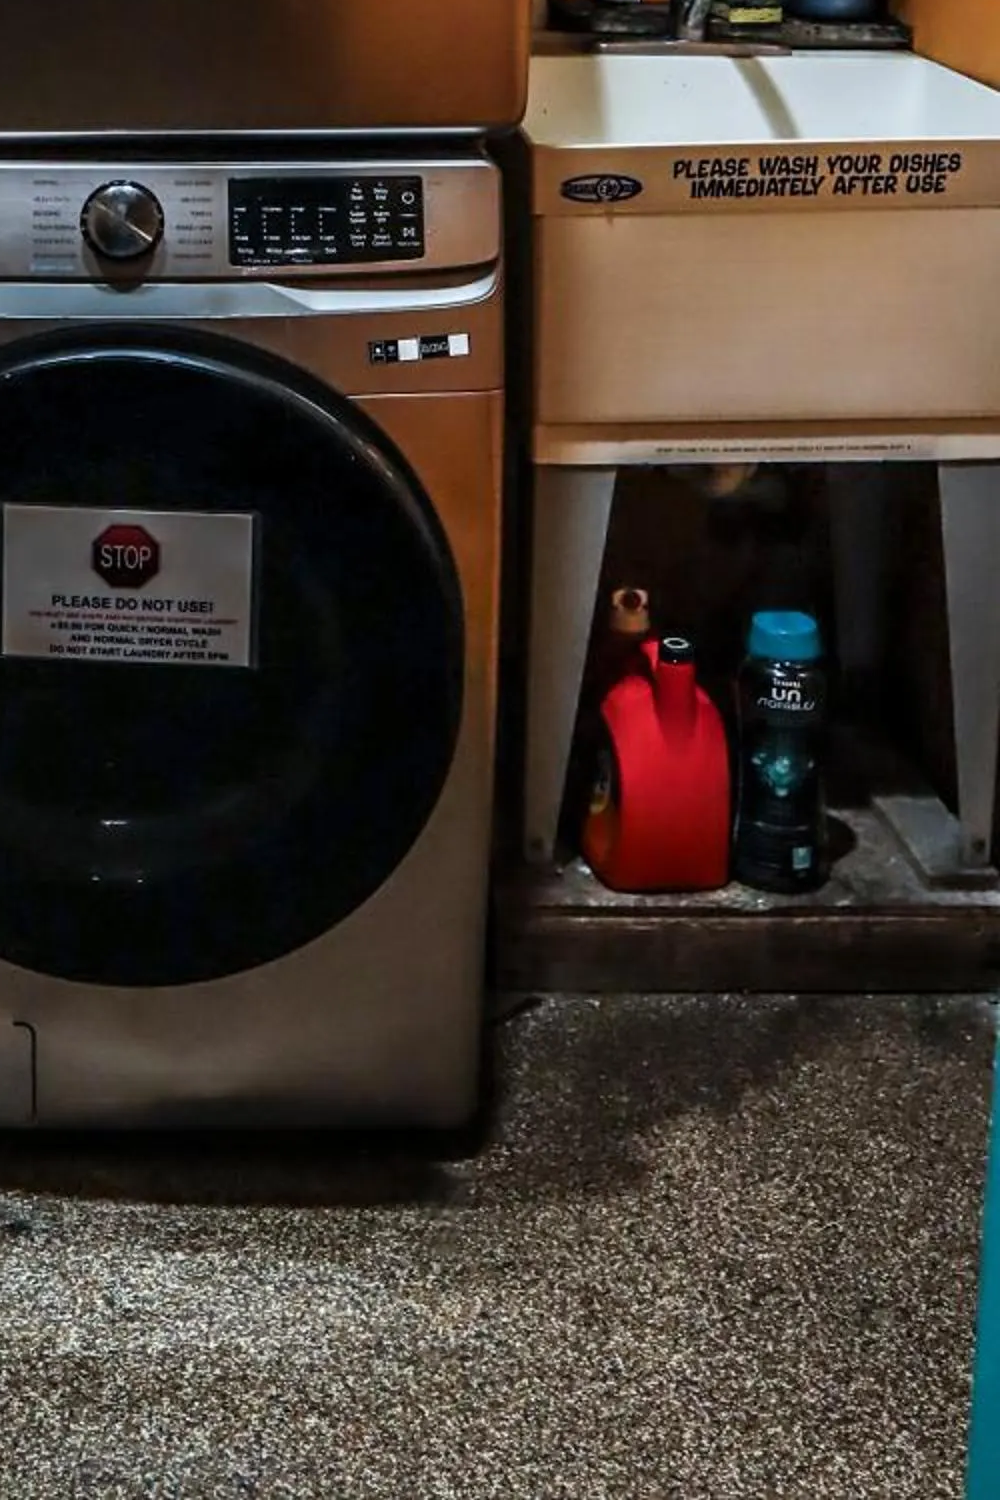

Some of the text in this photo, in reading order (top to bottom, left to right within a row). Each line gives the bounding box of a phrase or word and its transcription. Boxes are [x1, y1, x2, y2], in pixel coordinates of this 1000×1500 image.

[673, 152, 962, 179] PLEASE WASH YOUR DISHES
[690, 173, 947, 199] IMMEDIATELY AFTER USE
[100, 545, 150, 570] STOP
[52, 595, 214, 613] PLEASE DO NOT USE!
[107, 623, 138, 632] QUICK
[147, 625, 189, 635] NORMAL
[93, 636, 136, 645] NORMAL
